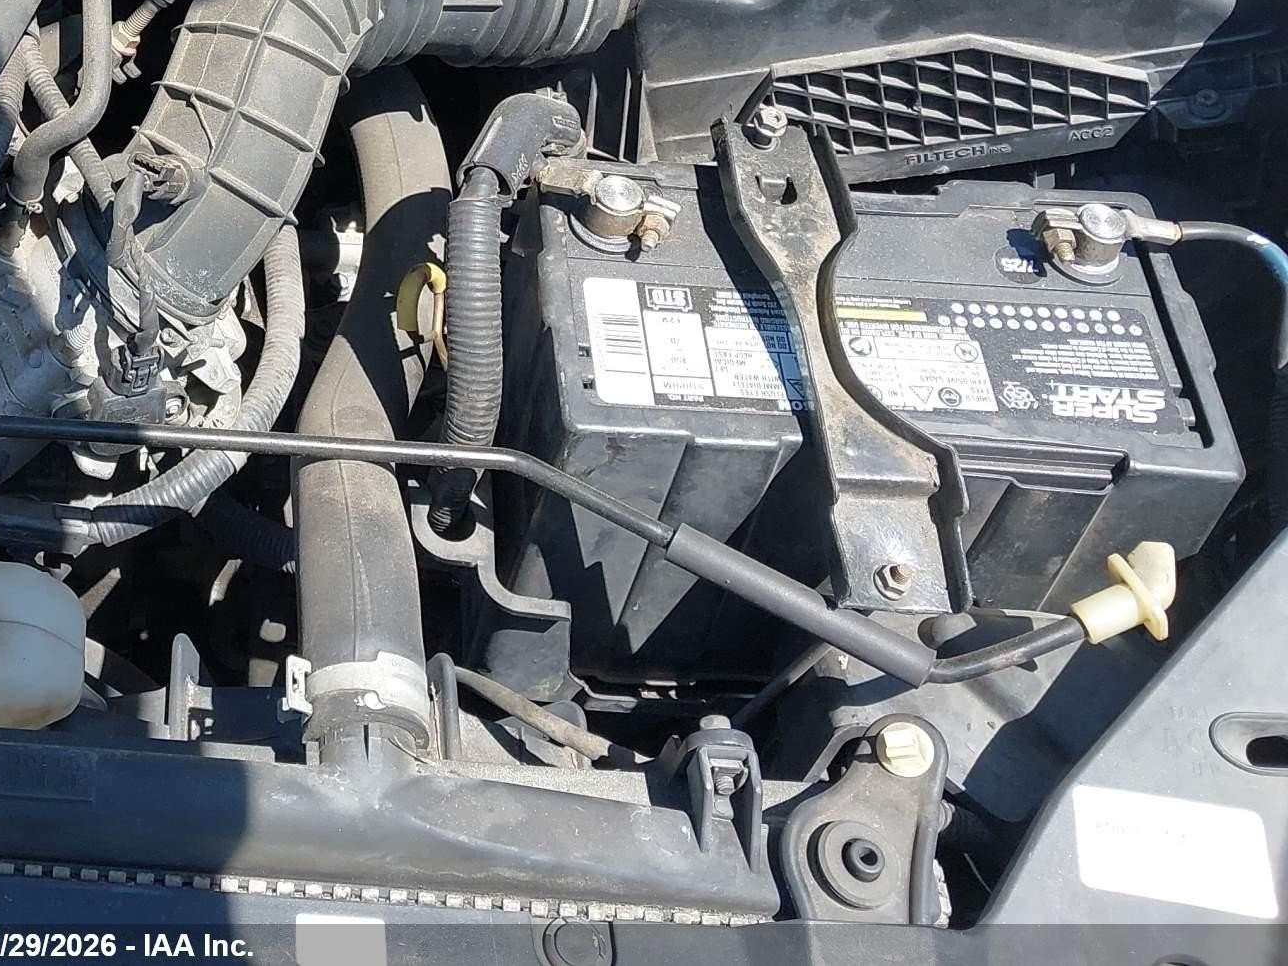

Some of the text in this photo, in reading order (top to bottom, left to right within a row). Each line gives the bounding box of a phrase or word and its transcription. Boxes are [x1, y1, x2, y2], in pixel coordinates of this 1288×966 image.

[904, 144, 987, 165] FILTECH
[652, 290, 687, 306] STD
[1048, 385, 1165, 410] START
[1052, 403, 1157, 424] SUPER
